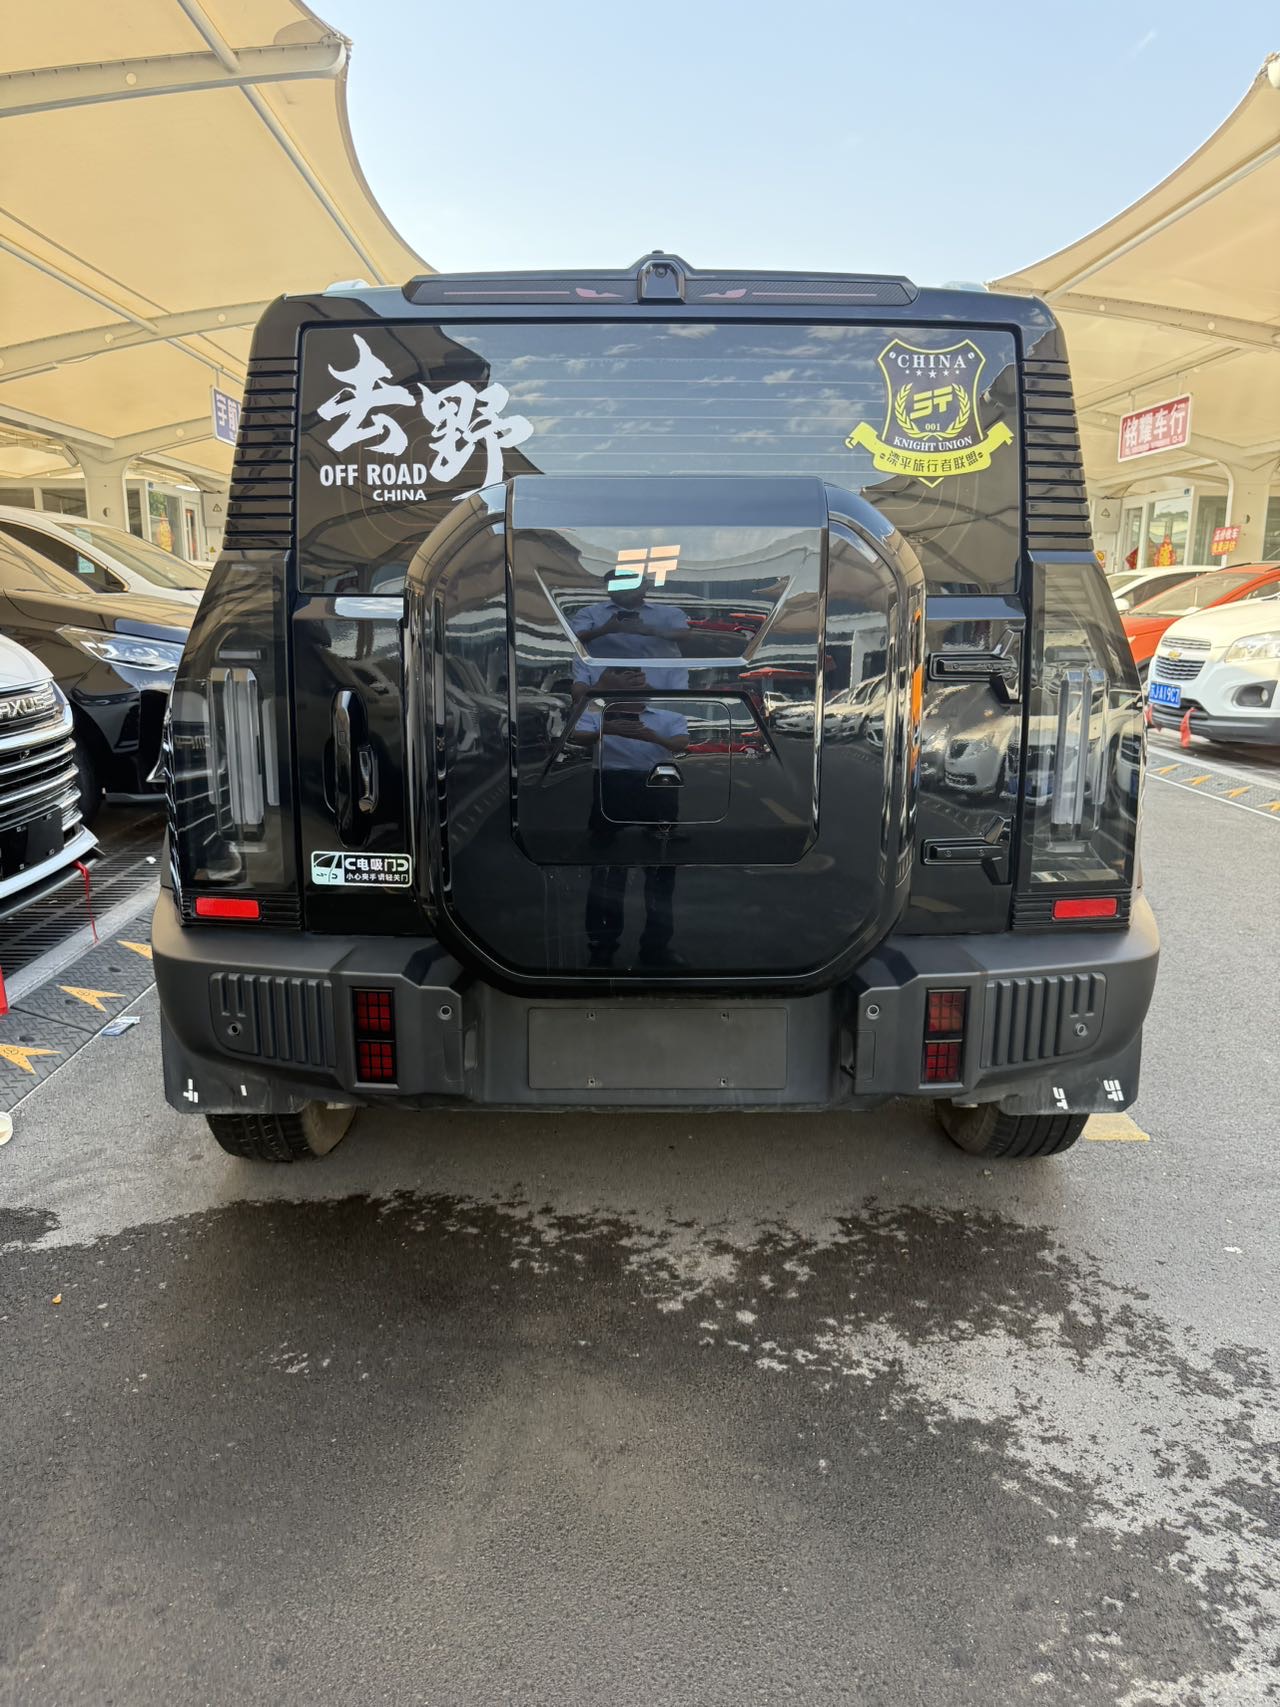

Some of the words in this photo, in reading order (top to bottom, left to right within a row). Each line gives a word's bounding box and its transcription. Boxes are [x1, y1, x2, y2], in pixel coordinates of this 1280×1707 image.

[897, 354, 967, 369] CHINA
[317, 334, 534, 501] 去野
[925, 423, 941, 432] 001
[893, 436, 936, 451] KNIGHT
[938, 435, 973, 451] UNION
[320, 463, 359, 487] OFF
[367, 462, 427, 485] ROAD
[372, 488, 427, 502] CHINA
